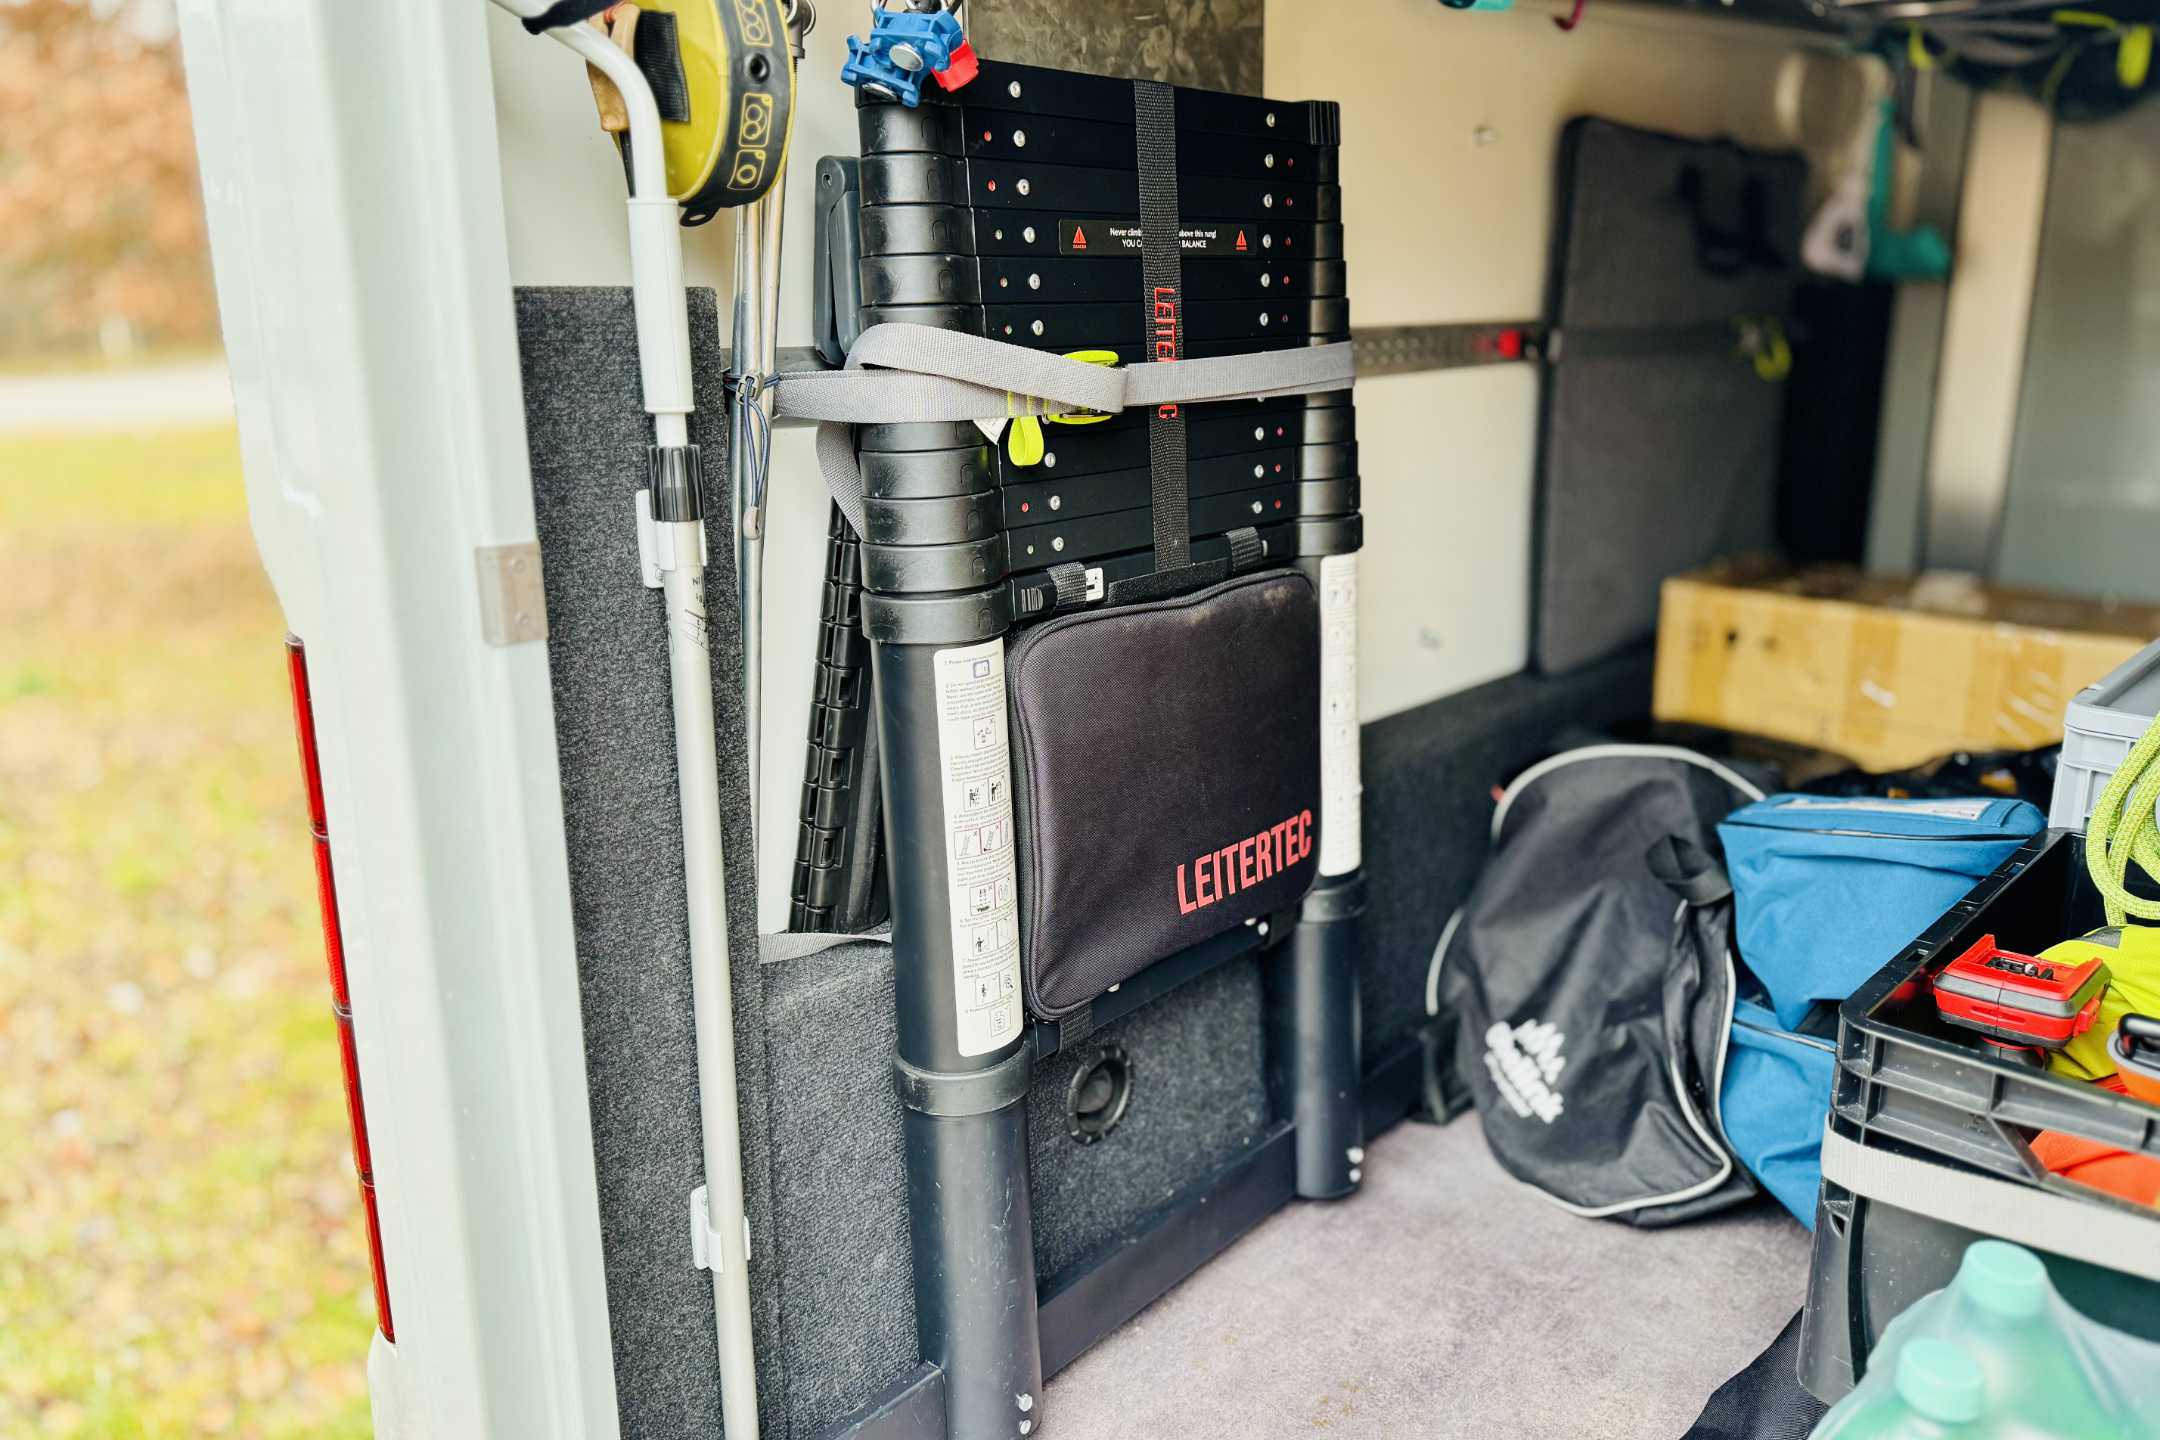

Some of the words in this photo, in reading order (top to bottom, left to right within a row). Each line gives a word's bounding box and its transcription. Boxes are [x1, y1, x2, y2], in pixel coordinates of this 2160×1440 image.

[1109, 227, 1127, 237] Never
[1127, 227, 1143, 237] climb
[1179, 229, 1194, 238] above
[1194, 229, 1204, 238] this
[1121, 238, 1136, 248] YOU
[1181, 239, 1207, 249] BALANCE
[1154, 287, 1178, 419] LEITEC
[1177, 809, 1312, 915] LEITERTEC
